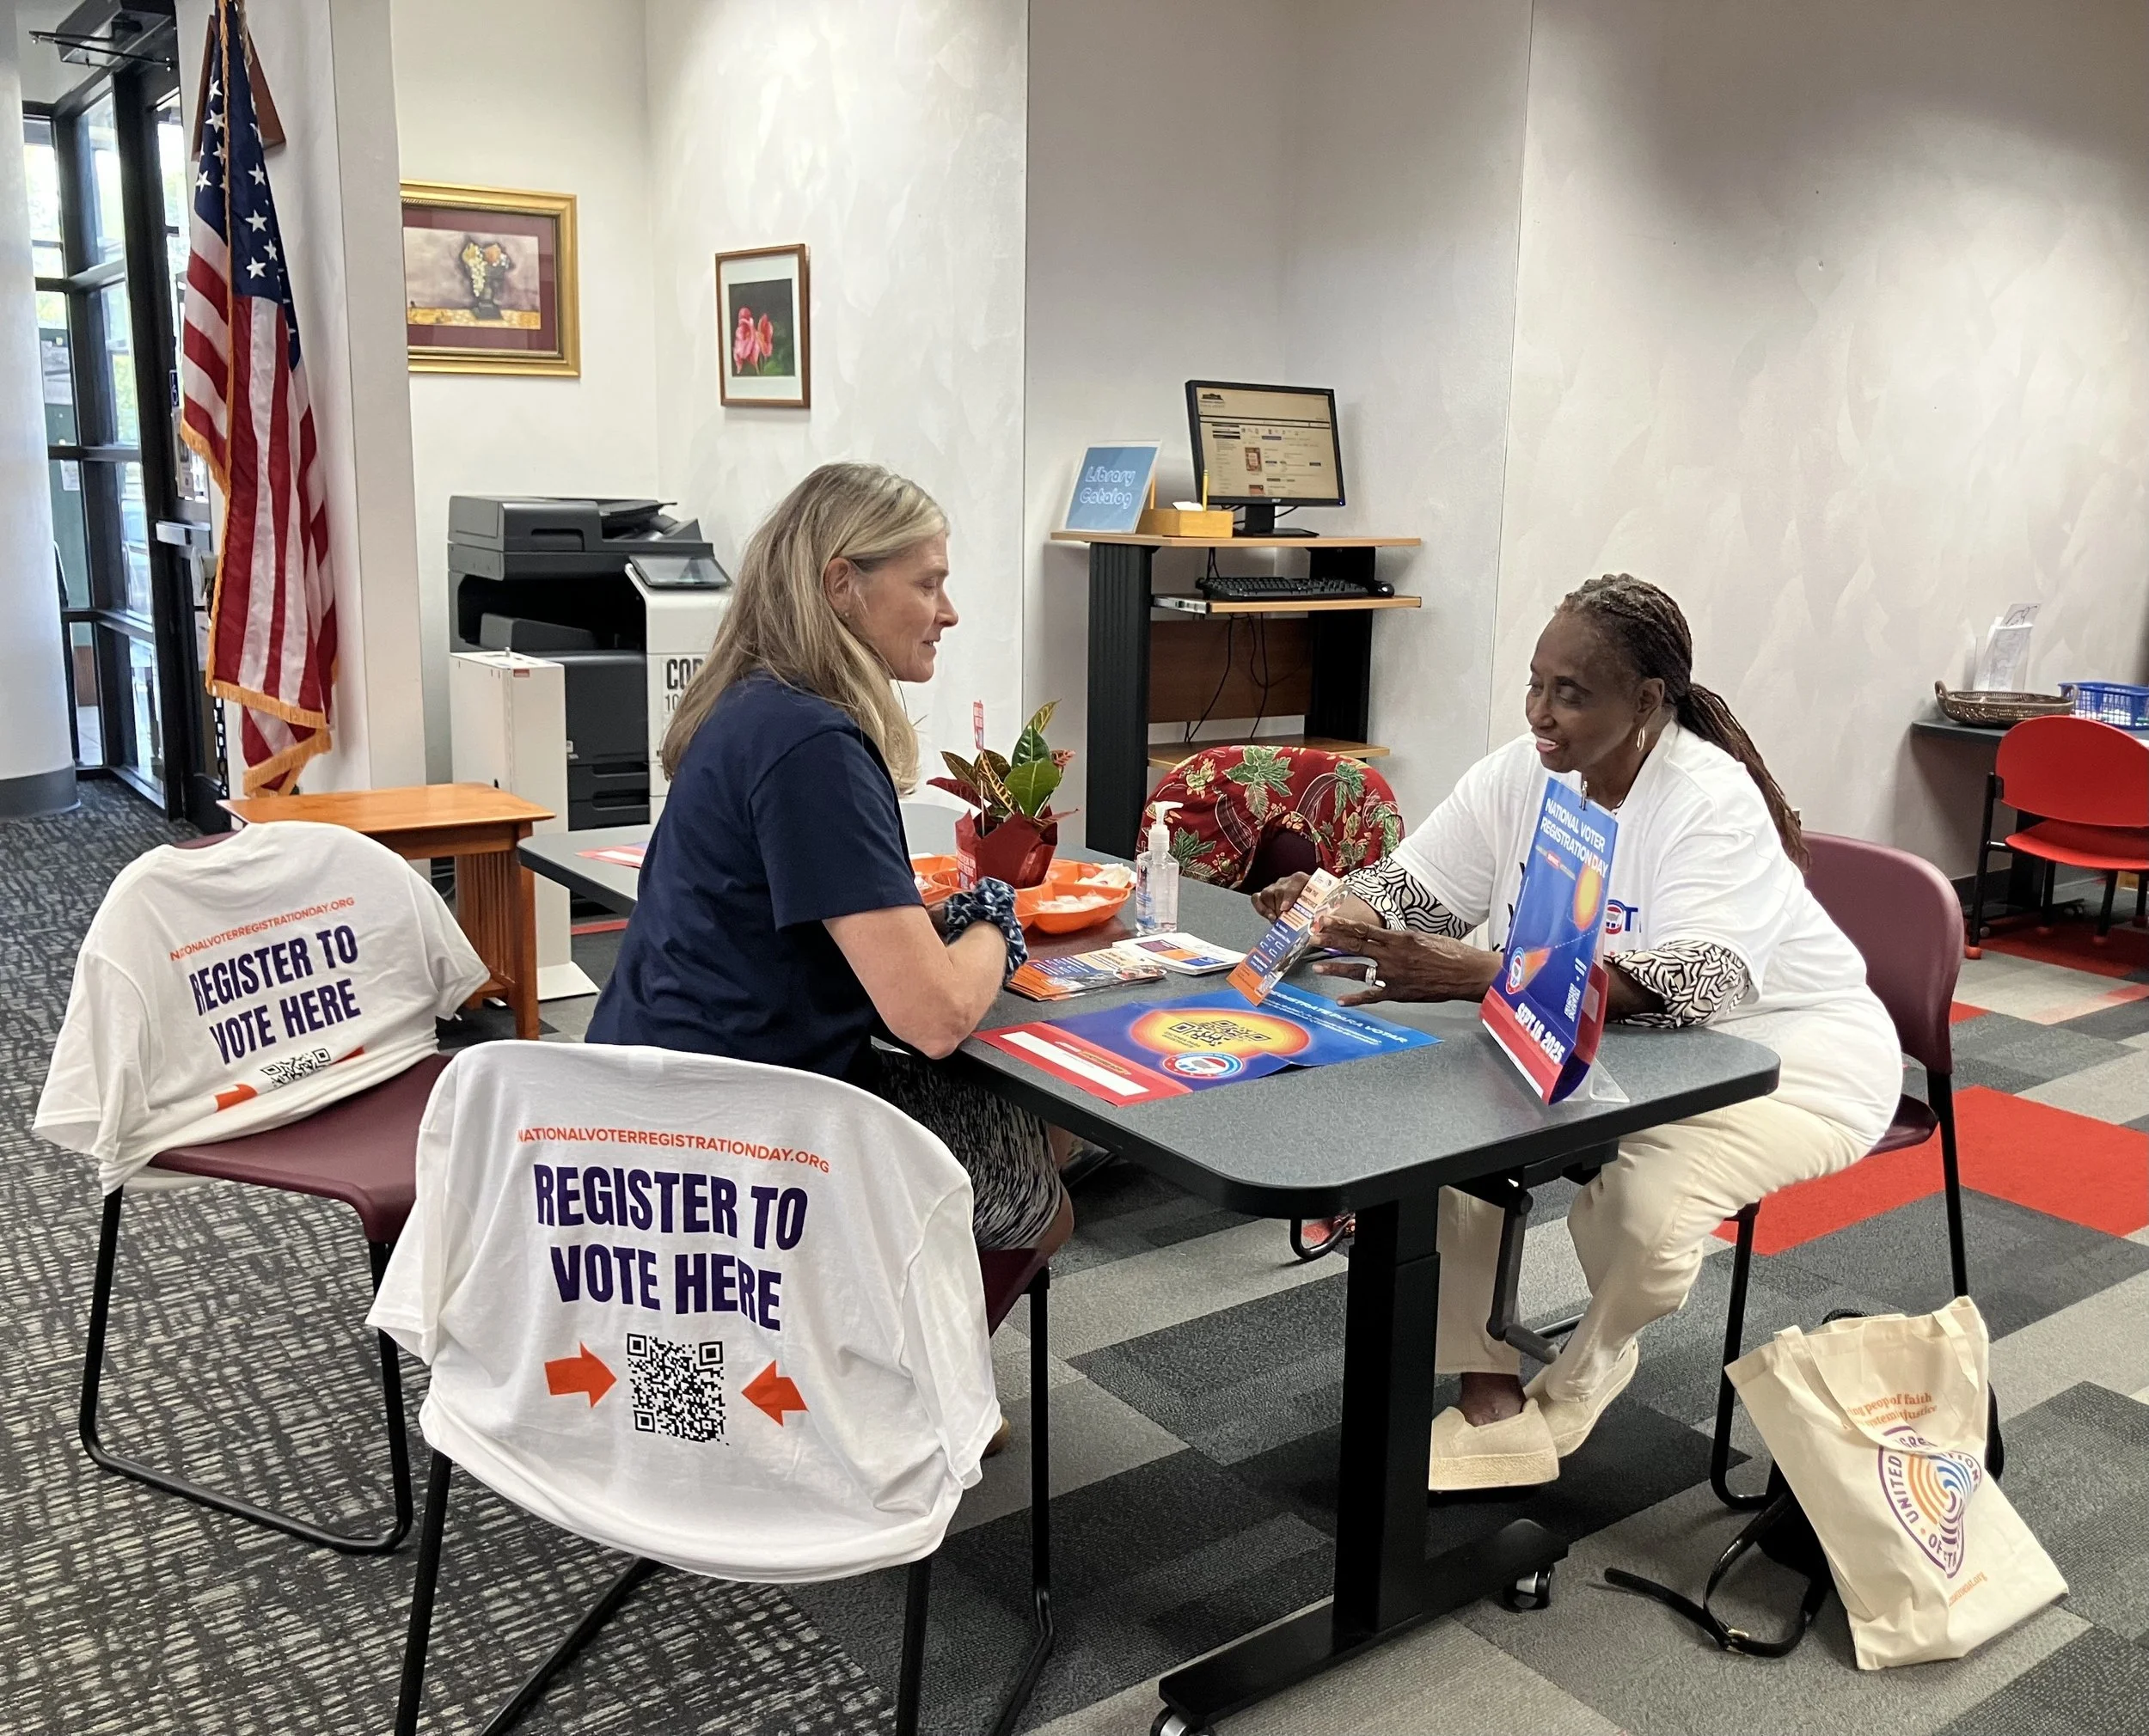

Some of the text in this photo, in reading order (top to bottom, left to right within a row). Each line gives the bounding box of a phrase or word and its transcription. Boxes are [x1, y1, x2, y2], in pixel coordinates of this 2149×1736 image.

[1080, 487, 1132, 509] Catalog
[1085, 466, 1136, 486] Library
[1540, 817, 1593, 866] REGISTRATION
[1589, 853, 1609, 878] DAY
[1546, 798, 1606, 853] NATIONAL VOTER
[189, 925, 358, 1016] REGISTER TO
[209, 978, 361, 1065] VOTE HERE
[1540, 1031, 1565, 1065] 2025
[534, 1164, 808, 1251] REGISTER TO
[550, 1244, 782, 1331] VOTE HERE
[1891, 1394, 1902, 1405] of
[1905, 1392, 1932, 1404] faith
[1888, 1454, 1919, 1524] UNITED
